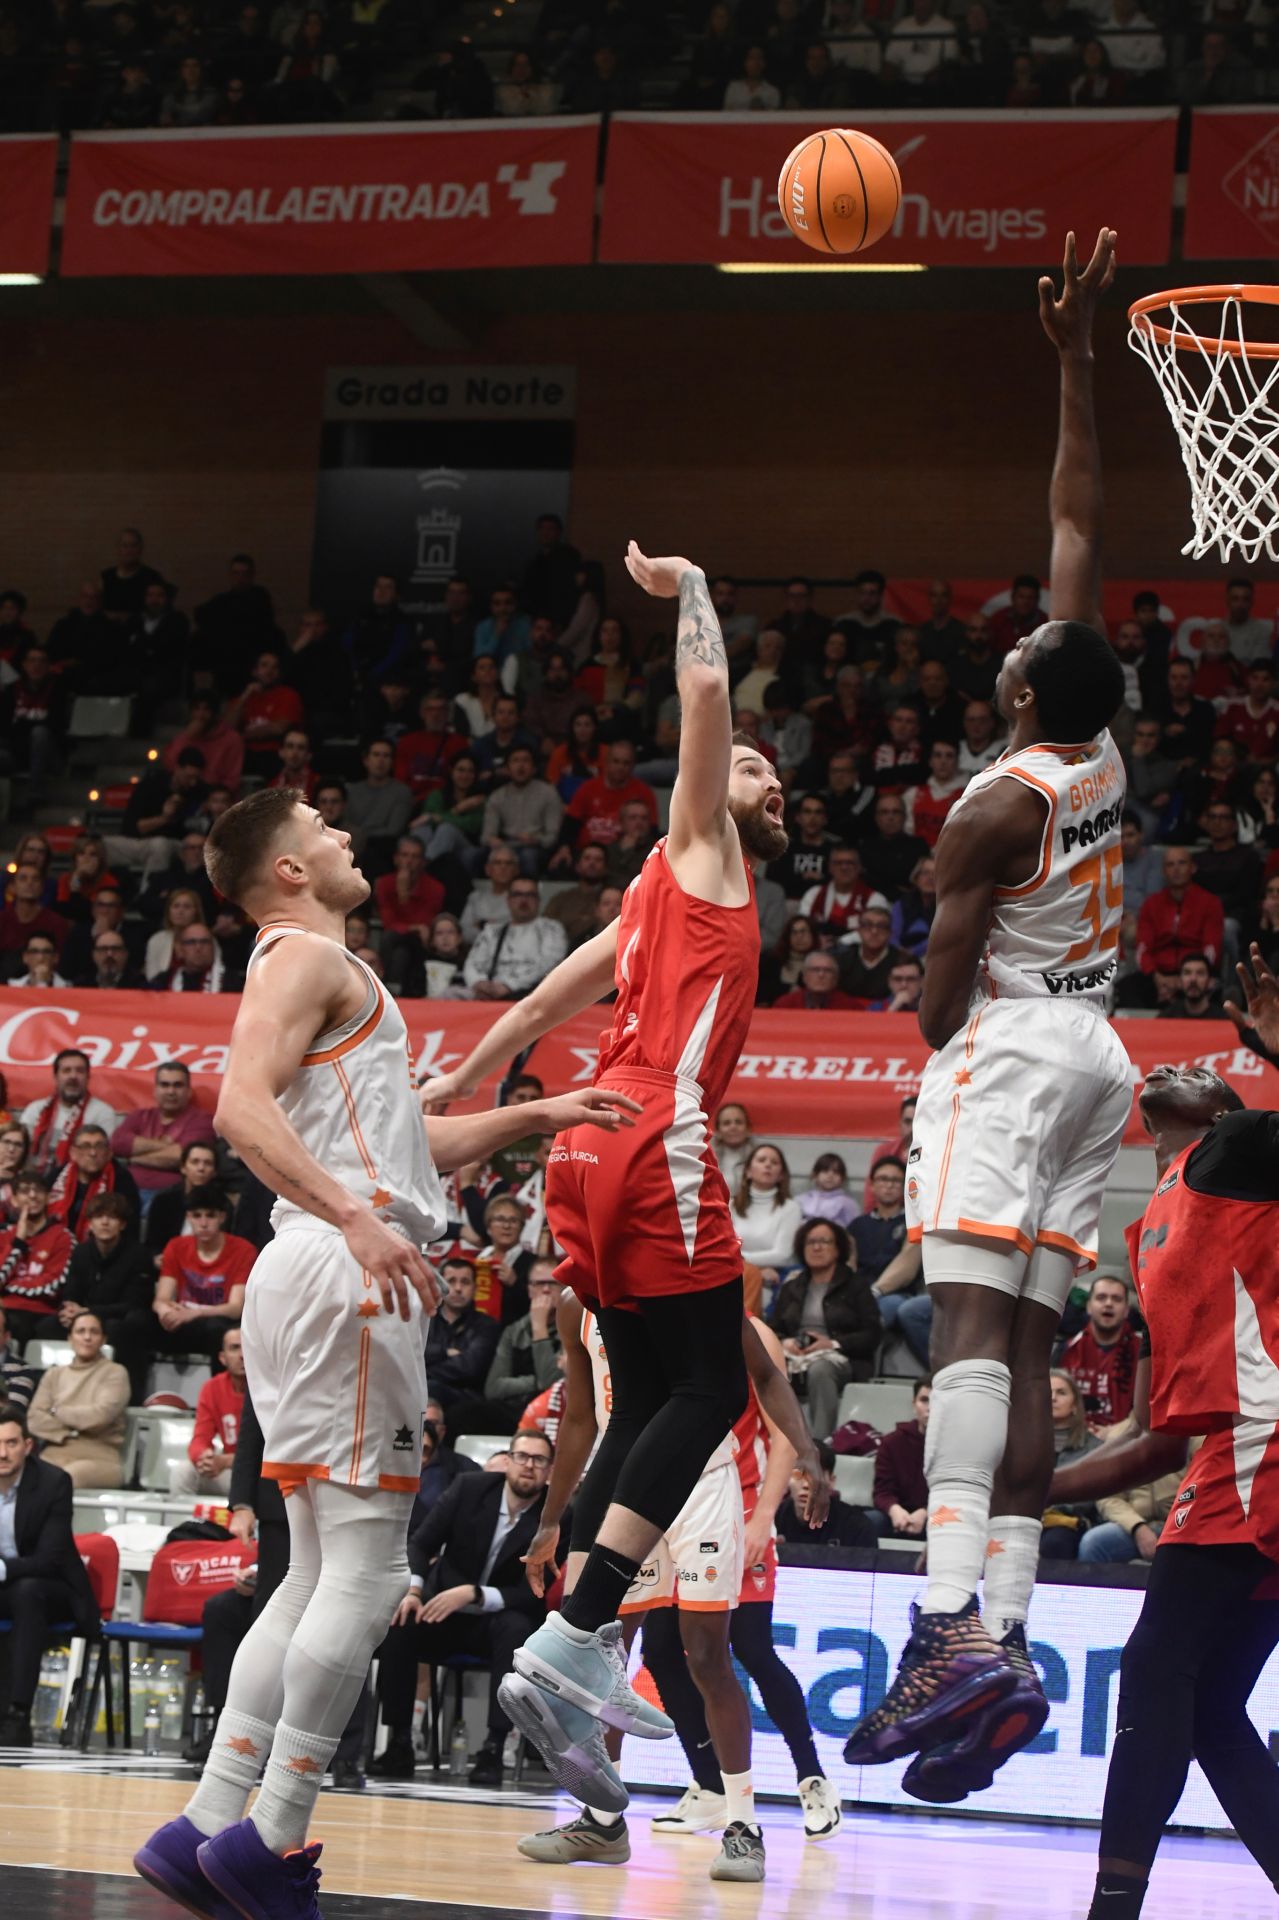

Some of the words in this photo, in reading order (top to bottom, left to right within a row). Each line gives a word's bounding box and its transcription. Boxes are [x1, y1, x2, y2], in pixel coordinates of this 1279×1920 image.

[93, 182, 491, 226] COMPRALAENTRADA
[792, 182, 809, 230] EVO
[337, 377, 449, 406] Grada
[466, 377, 564, 406] Norte
[1062, 845, 1123, 964] 35
[199, 1555, 242, 1570] UCAM
[700, 1544, 716, 1552] acb
